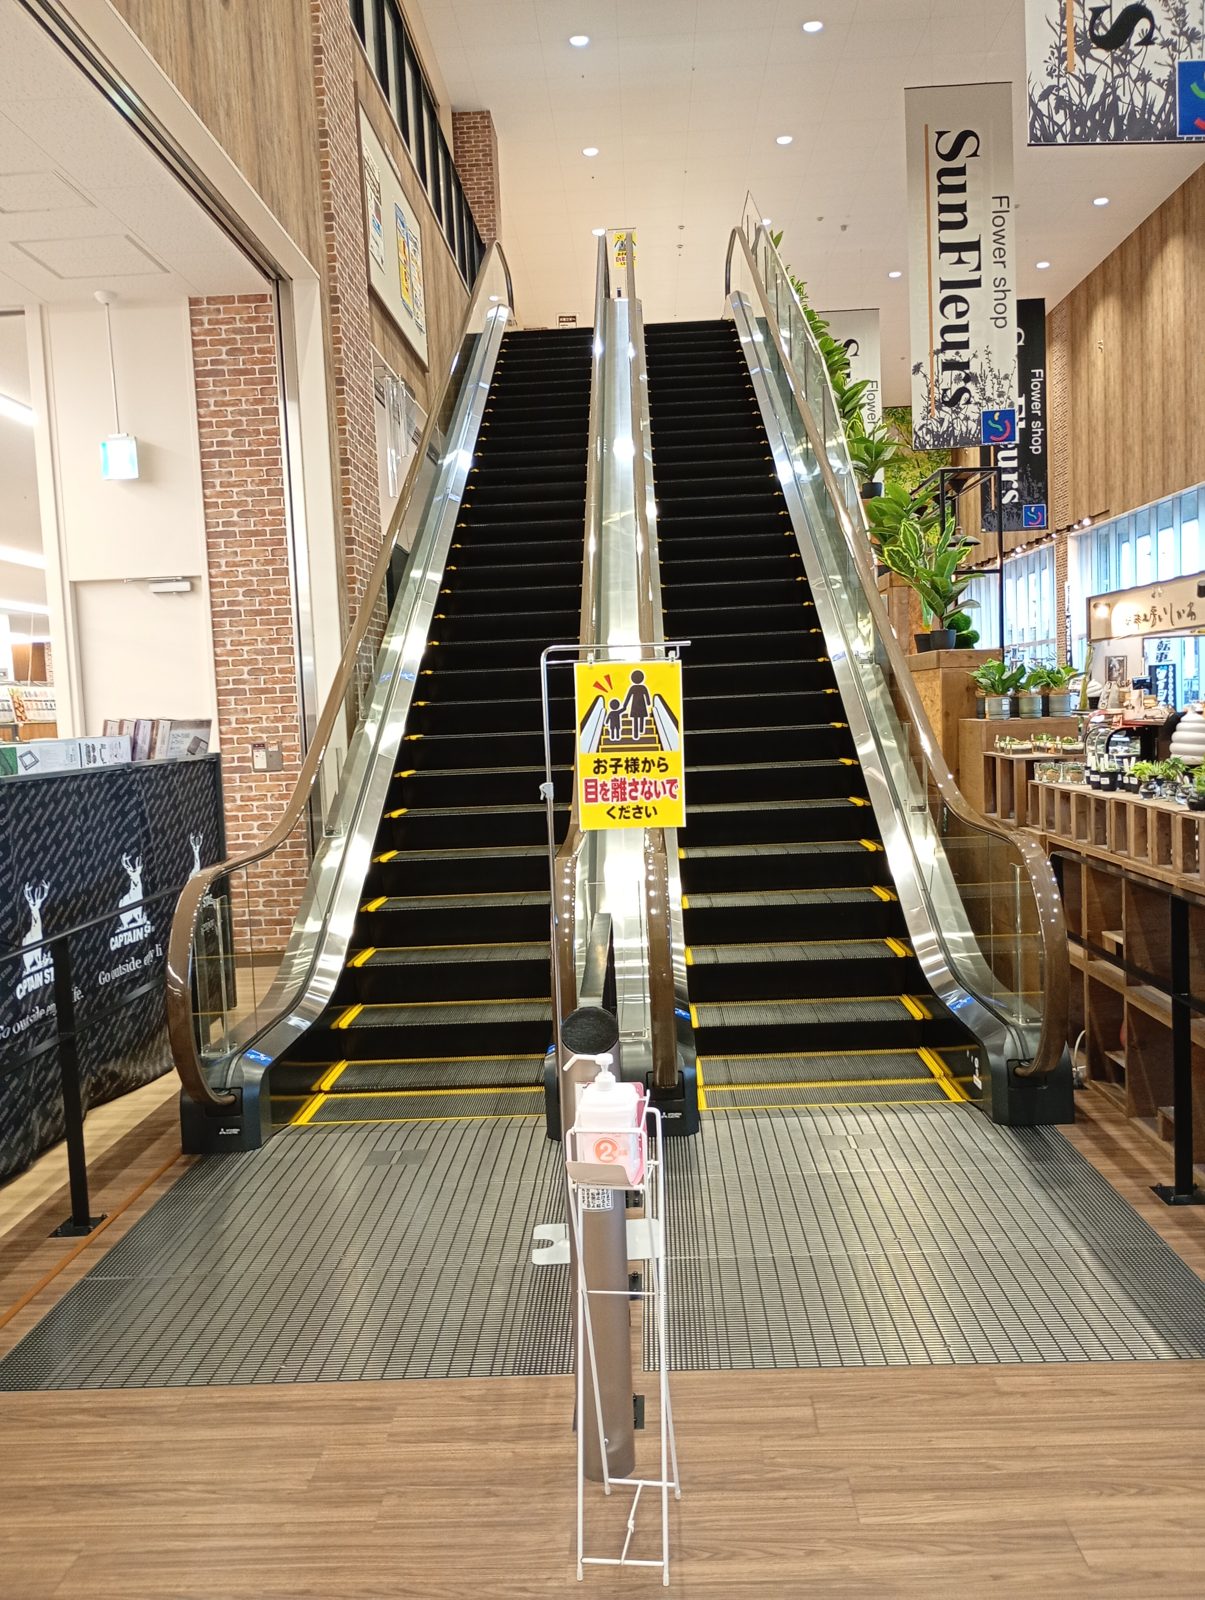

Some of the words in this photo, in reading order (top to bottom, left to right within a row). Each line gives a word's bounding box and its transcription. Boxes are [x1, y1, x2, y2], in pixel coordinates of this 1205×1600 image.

[991, 195, 1010, 272] Flower
[935, 129, 982, 408] SunFleurs
[989, 277, 1008, 329] shop
[1030, 369, 1044, 416] Flower
[1029, 420, 1044, 455] shop
[593, 757, 669, 774] お子様から
[584, 778, 678, 803] 目を離さないで
[606, 805, 658, 820] ください
[109, 927, 144, 951] CAPTAIN
[16, 970, 44, 1000] CPTAIN
[98, 971, 111, 986] Go
